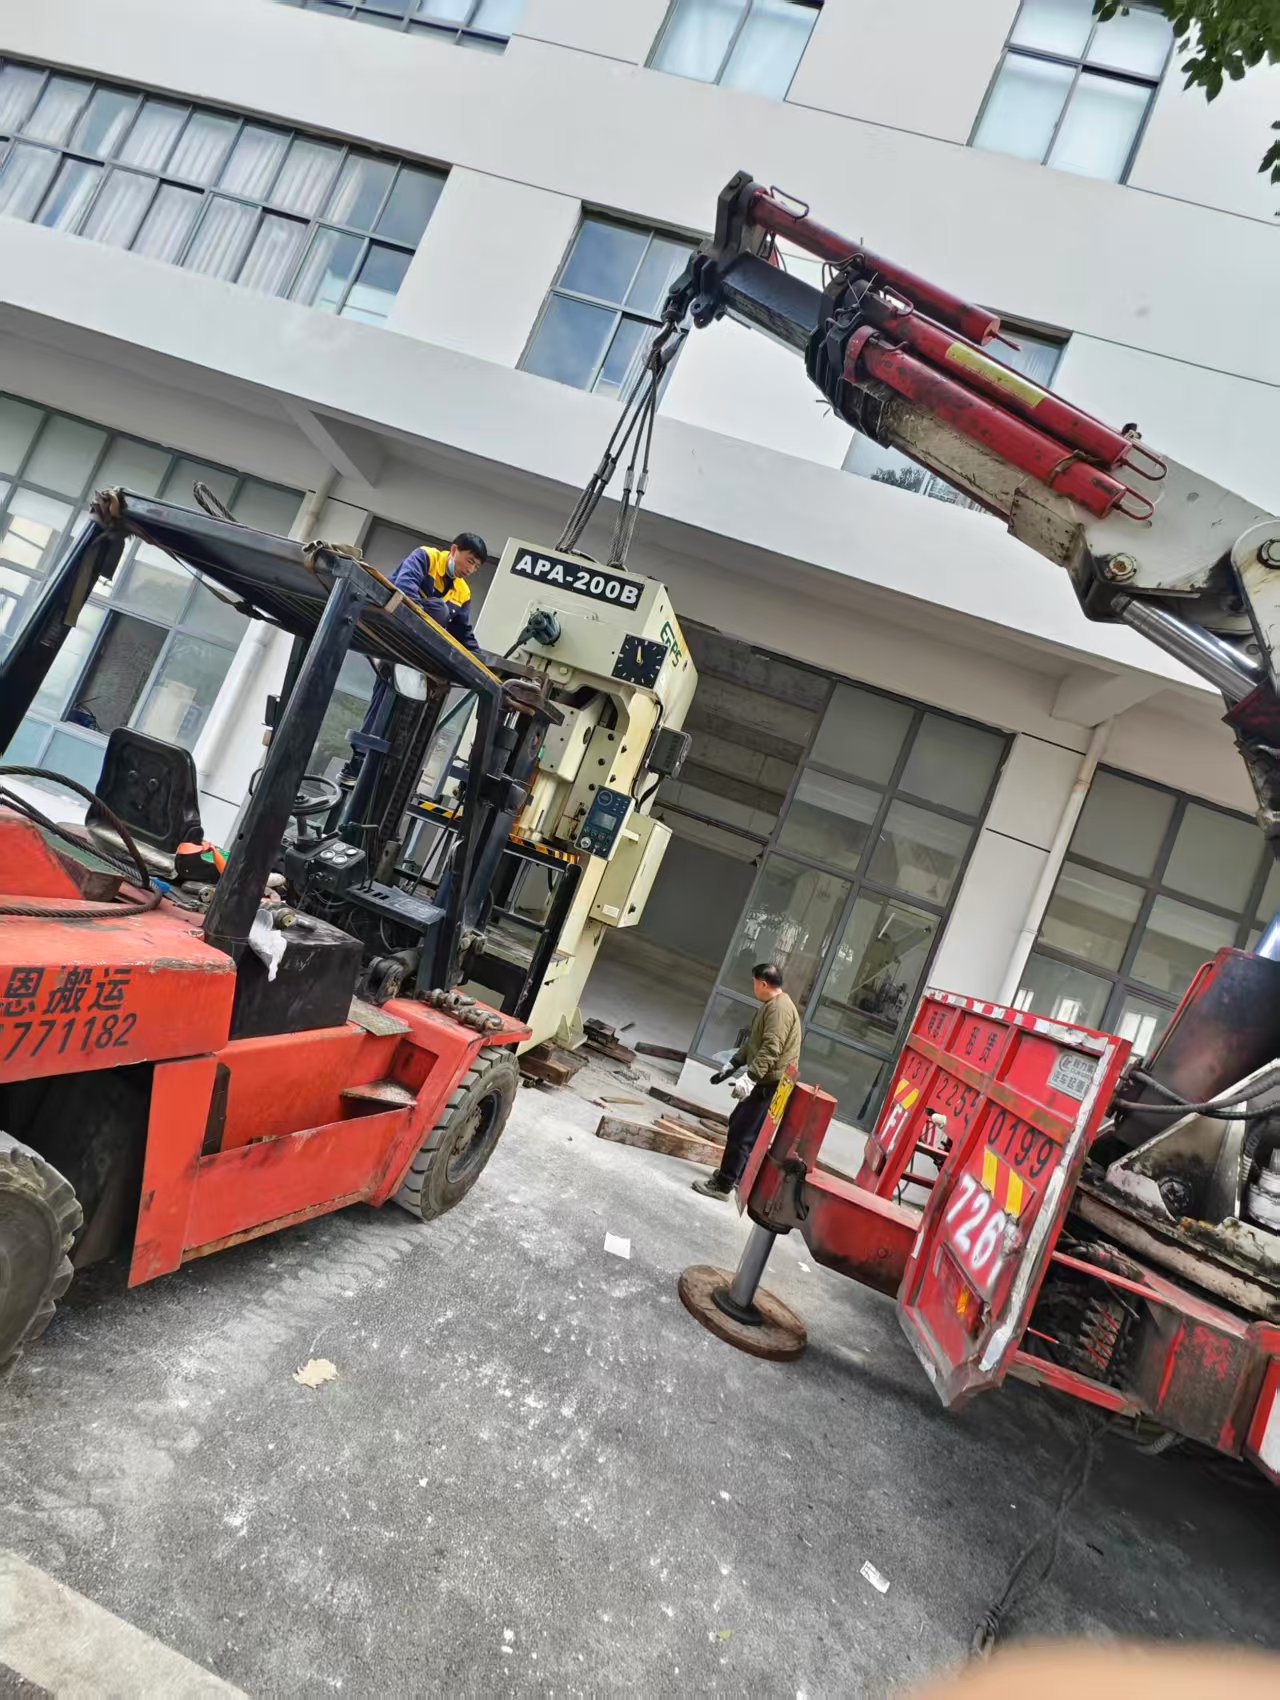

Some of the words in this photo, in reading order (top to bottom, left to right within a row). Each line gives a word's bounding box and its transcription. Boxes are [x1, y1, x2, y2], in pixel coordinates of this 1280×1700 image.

[515, 555, 639, 604] APA-200B
[0, 1012, 137, 1061] 771182
[987, 1111, 1055, 1177] 0199
